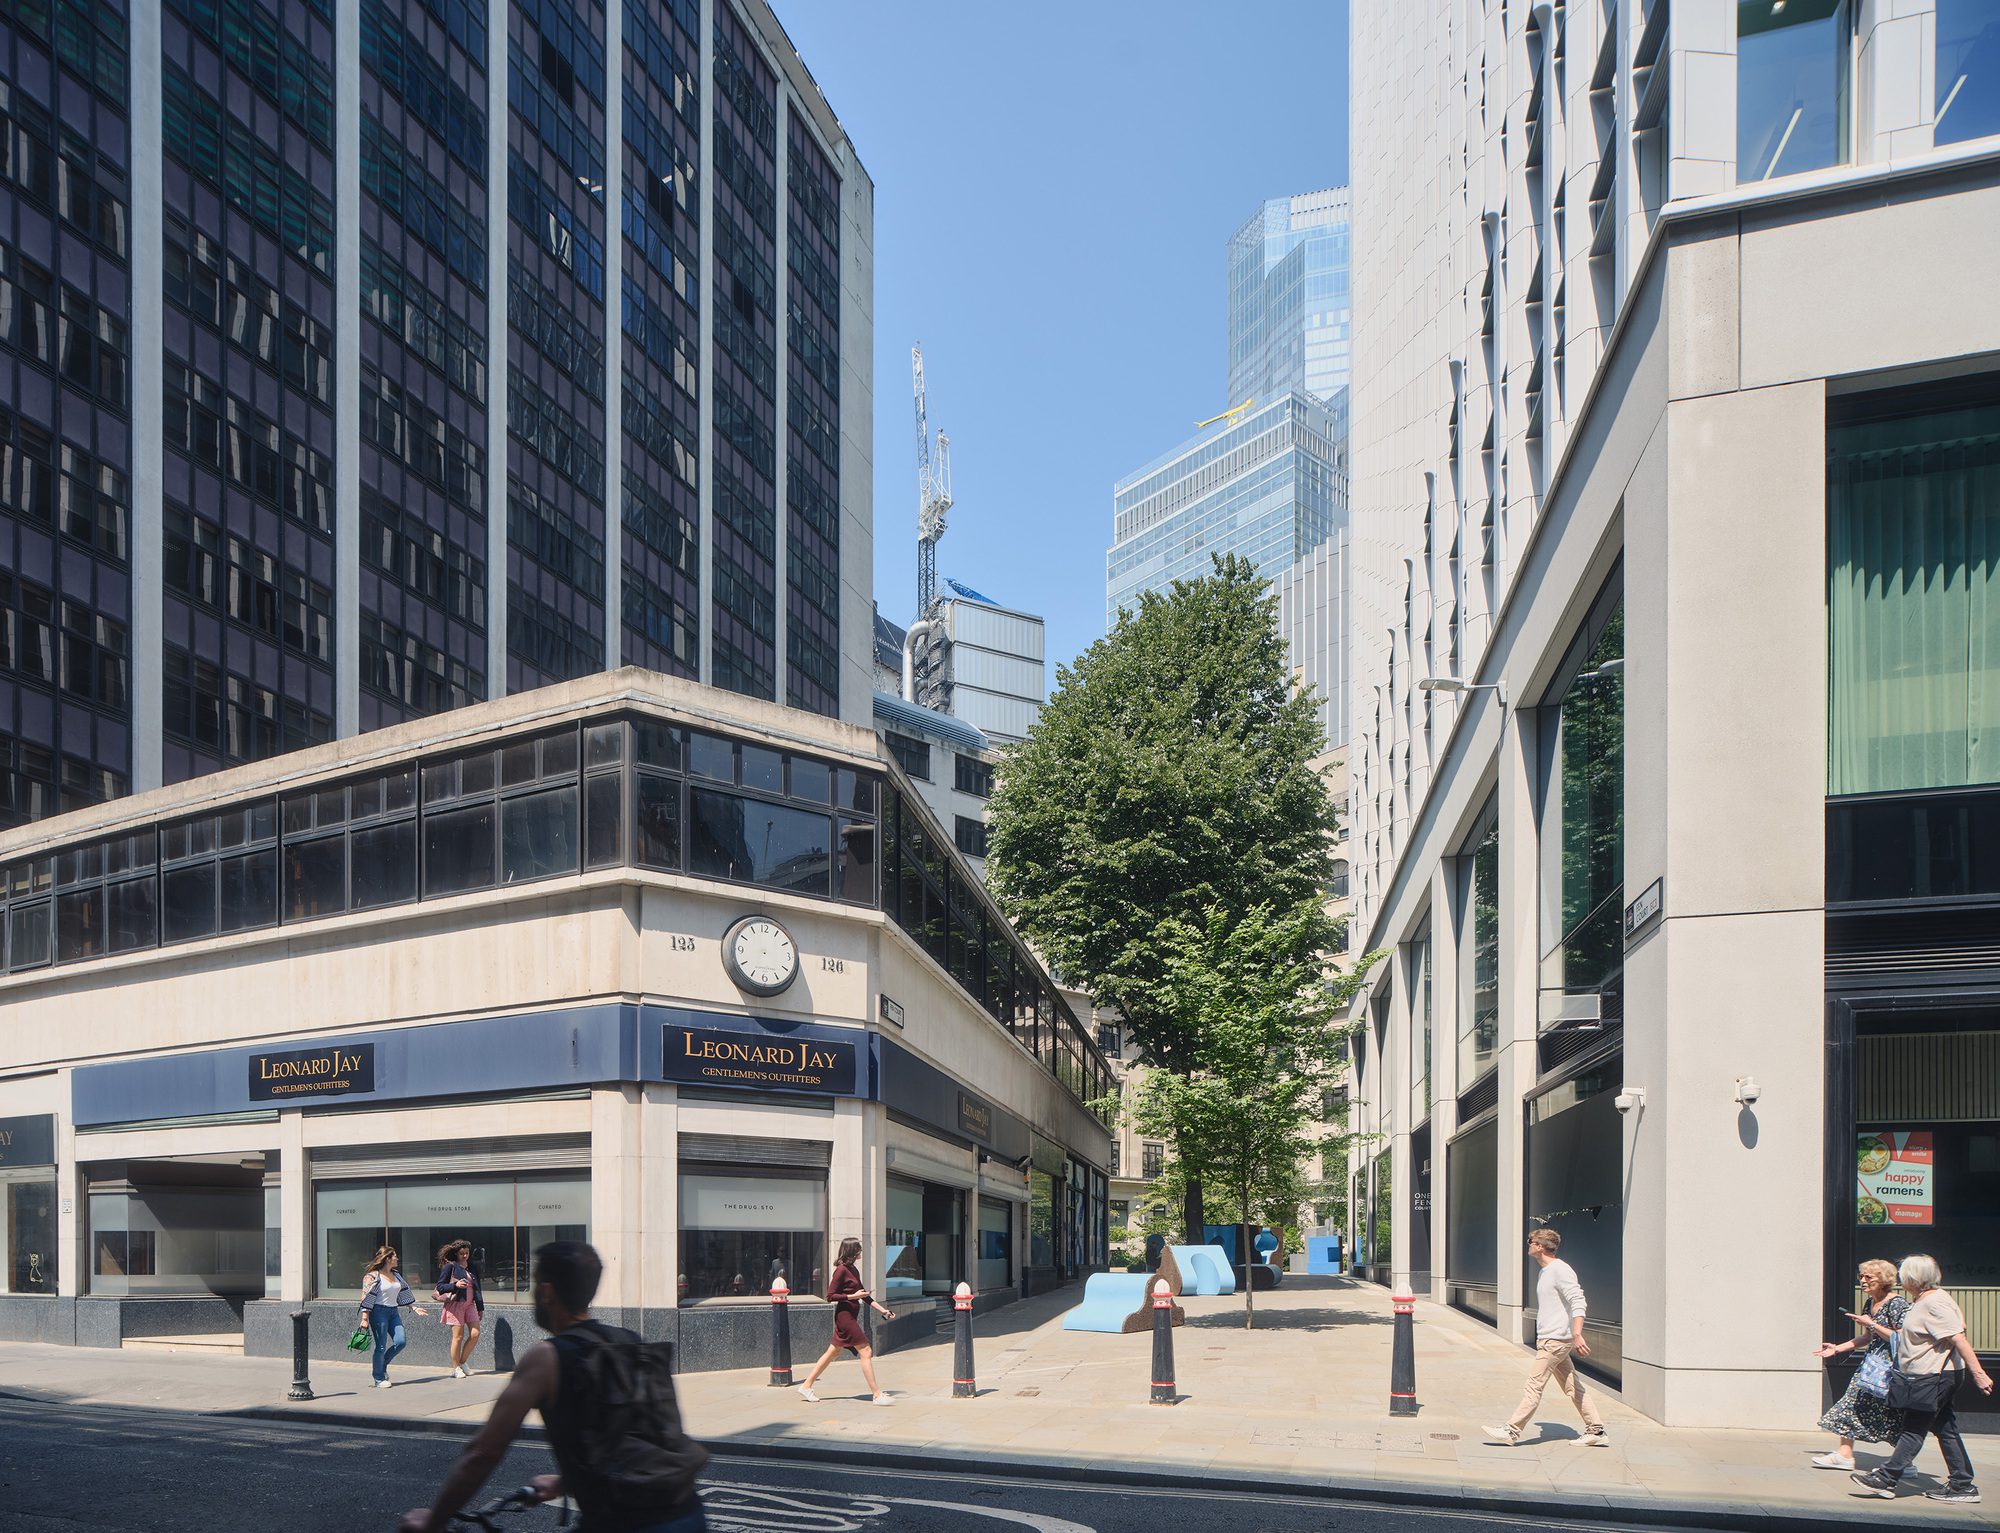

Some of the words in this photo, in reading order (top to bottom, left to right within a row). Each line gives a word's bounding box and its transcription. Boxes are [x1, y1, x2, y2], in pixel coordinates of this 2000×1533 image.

[760, 924, 769, 934] 12
[670, 935, 696, 952] 125
[737, 945, 744, 954] 9
[786, 953, 791, 962] 3
[821, 957, 845, 974] 126
[761, 974, 768, 983] 6
[683, 1031, 794, 1065] LEONARD
[798, 1043, 837, 1072] JAY
[260, 1058, 331, 1079] LEONARD
[332, 1050, 362, 1078] JAY
[702, 1067, 767, 1080] GENTLEMEN'S
[768, 1072, 821, 1085] OUTFITTERS
[271, 1083, 313, 1094] GENTLEMEN'S
[313, 1080, 350, 1091] OUTFITTERS
[1885, 1172, 1924, 1185] happy
[1876, 1186, 1924, 1196] ramens
